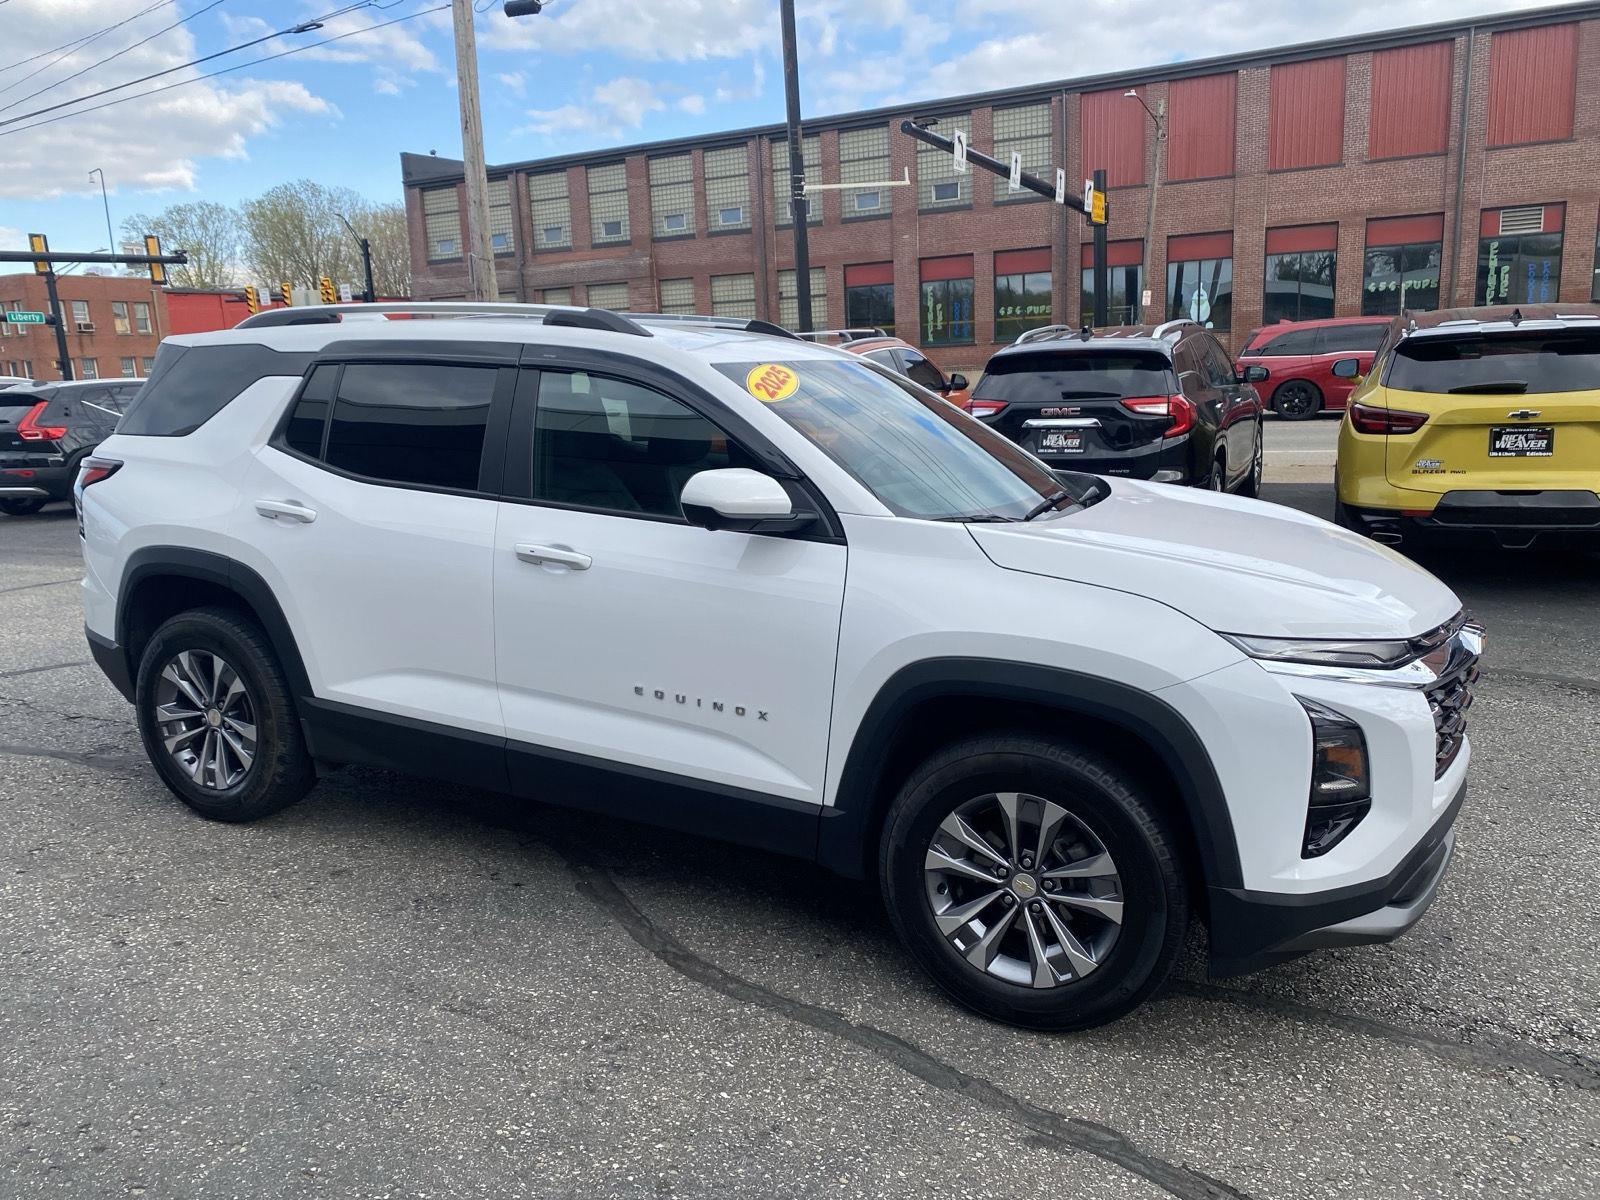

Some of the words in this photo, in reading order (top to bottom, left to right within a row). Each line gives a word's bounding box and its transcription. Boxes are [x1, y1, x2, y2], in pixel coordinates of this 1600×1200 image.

[11, 313, 39, 322] Liberty
[755, 365, 791, 399] 2025
[1040, 407, 1081, 416] GMC
[1495, 440, 1548, 449] WEAVER
[634, 686, 768, 721] EQUINOX
